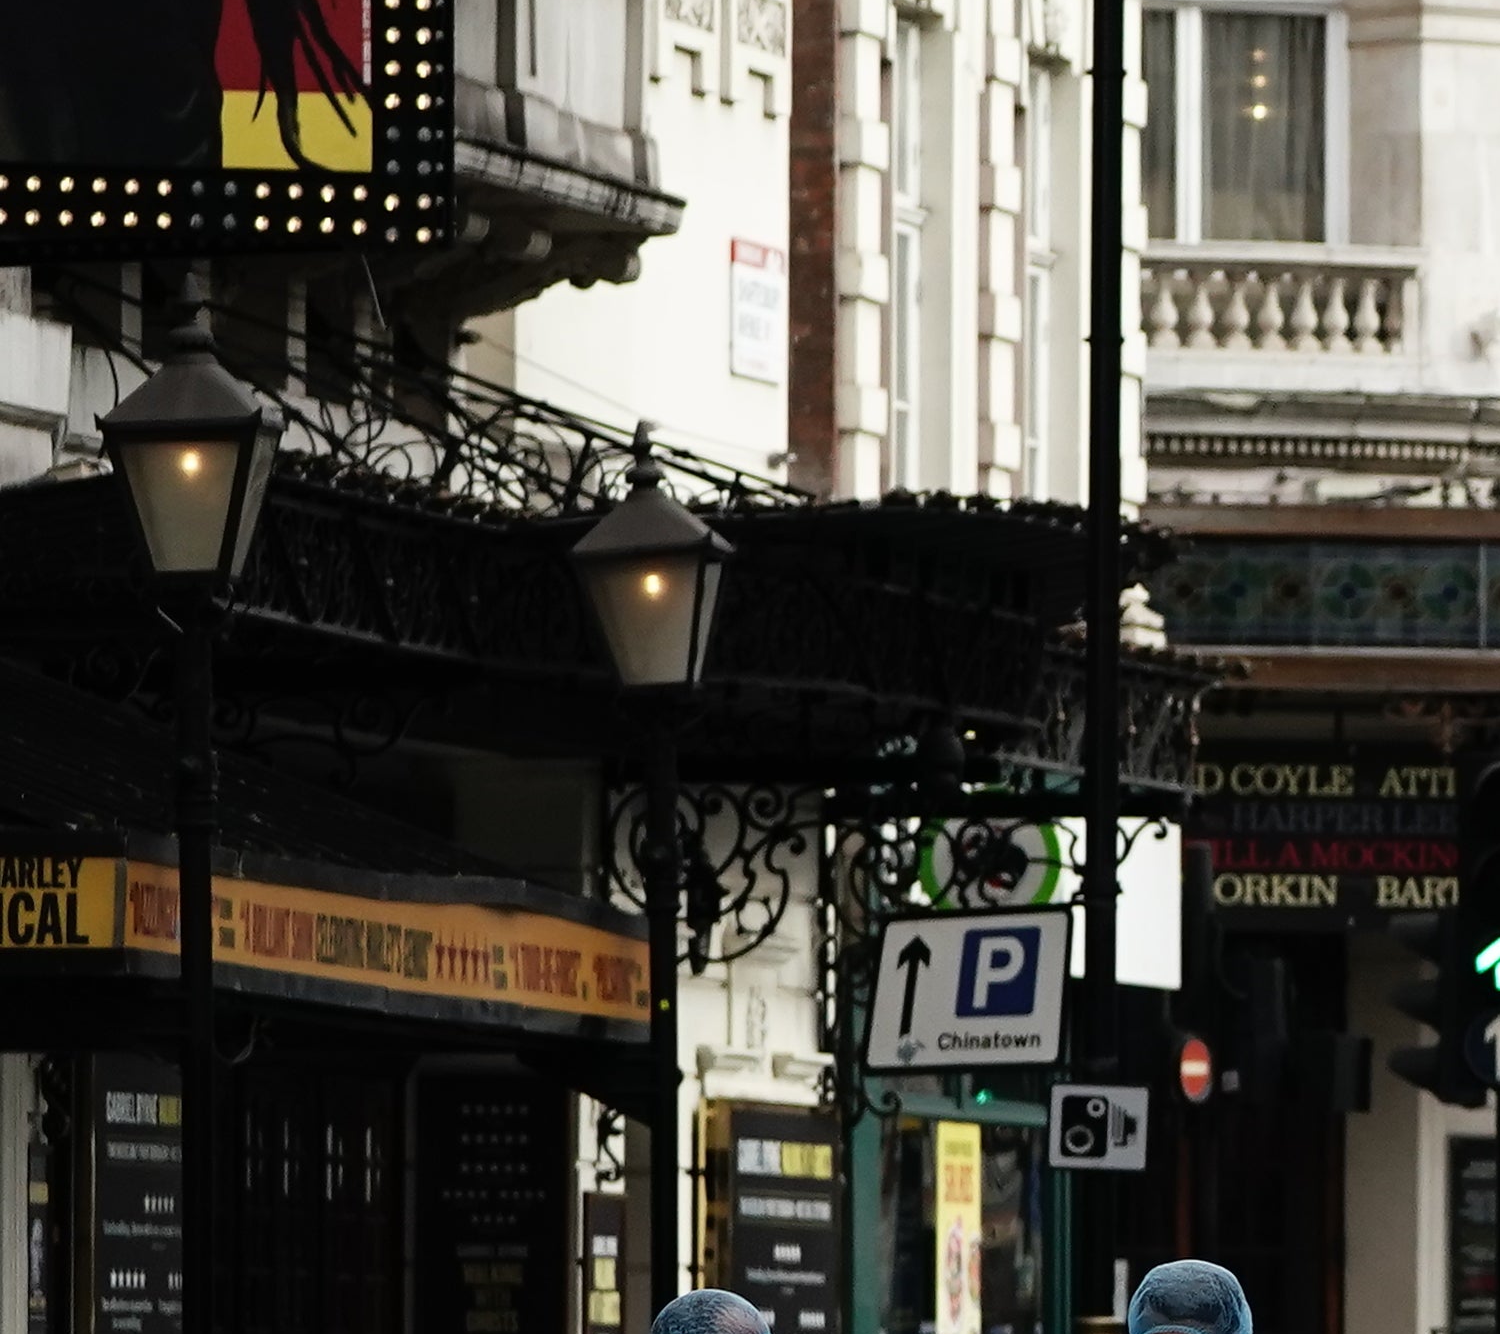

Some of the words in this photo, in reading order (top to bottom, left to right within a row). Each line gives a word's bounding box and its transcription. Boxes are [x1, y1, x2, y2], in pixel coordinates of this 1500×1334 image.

[1230, 763, 1356, 797] COYLE
[1211, 839, 1272, 869] ILL
[0, 856, 81, 889] ARLEY
[1213, 872, 1340, 907] ORKIN
[972, 936, 1026, 1009] P
[937, 1030, 1042, 1051] Chinatown
